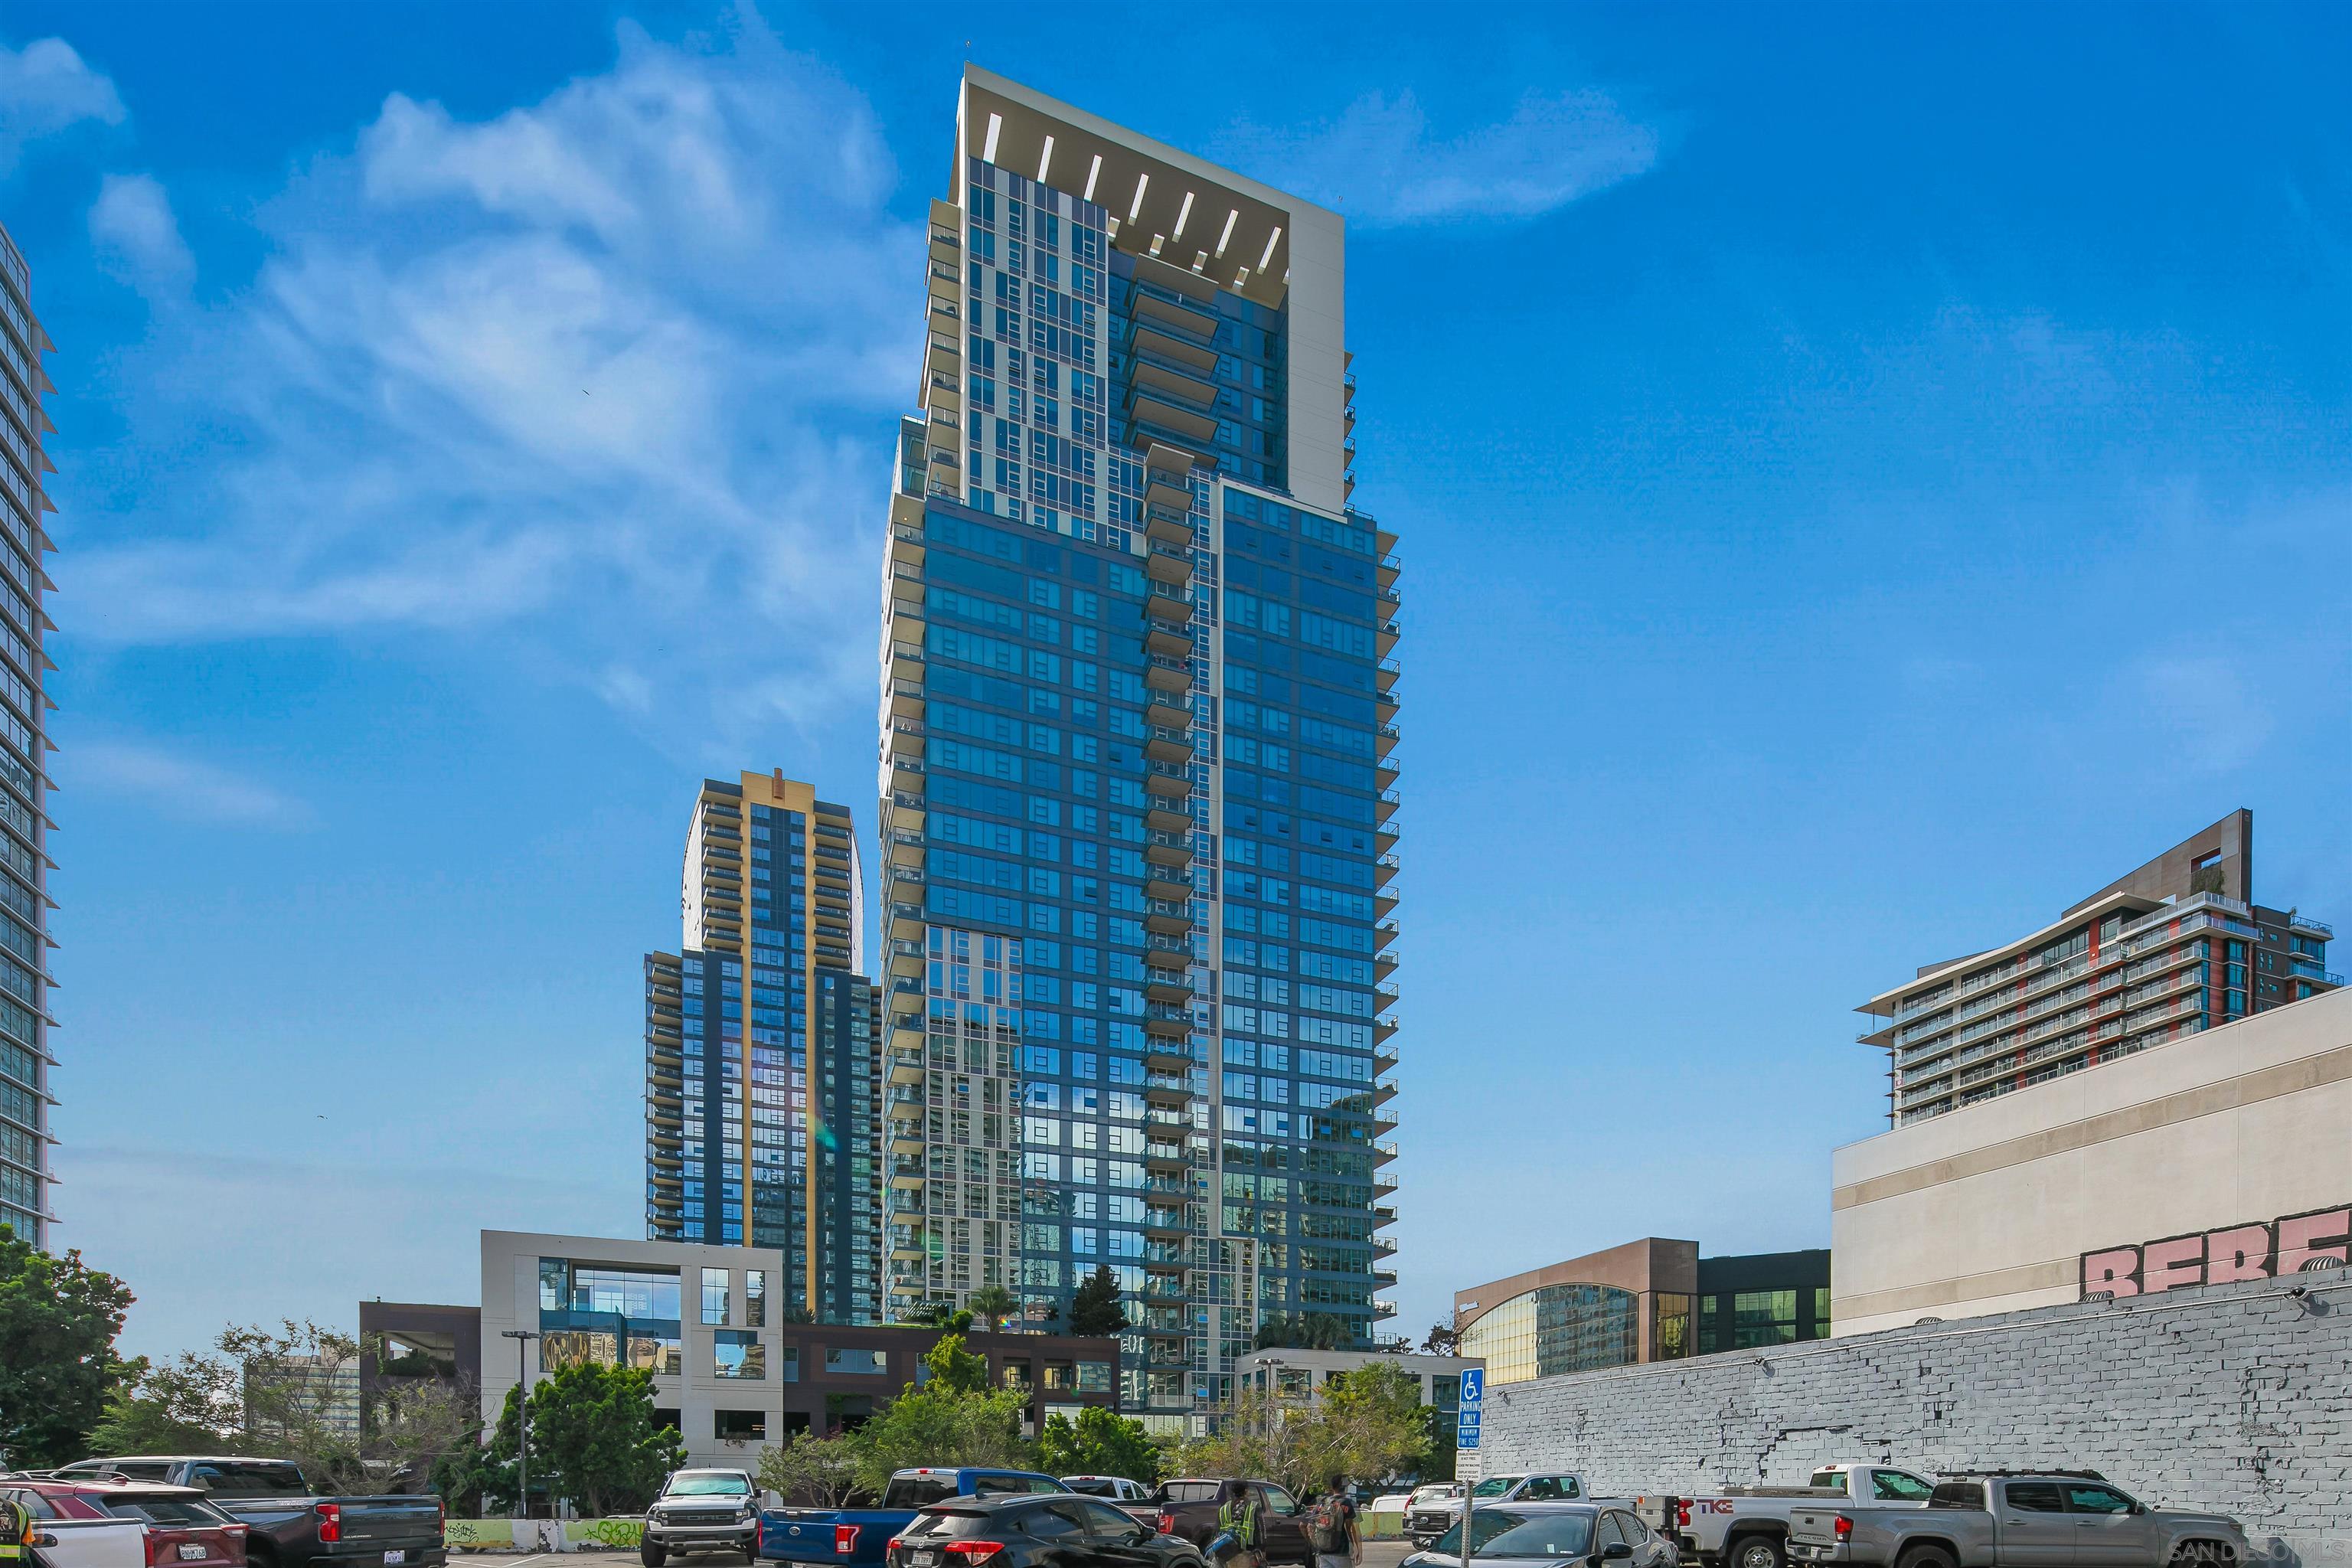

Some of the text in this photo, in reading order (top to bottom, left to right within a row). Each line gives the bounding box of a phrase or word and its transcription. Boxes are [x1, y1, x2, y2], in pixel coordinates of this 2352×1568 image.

[1461, 1400, 1481, 1413] PARKING
[1463, 1413, 1476, 1425] ONLY
[1696, 1499, 1734, 1514] TKE
